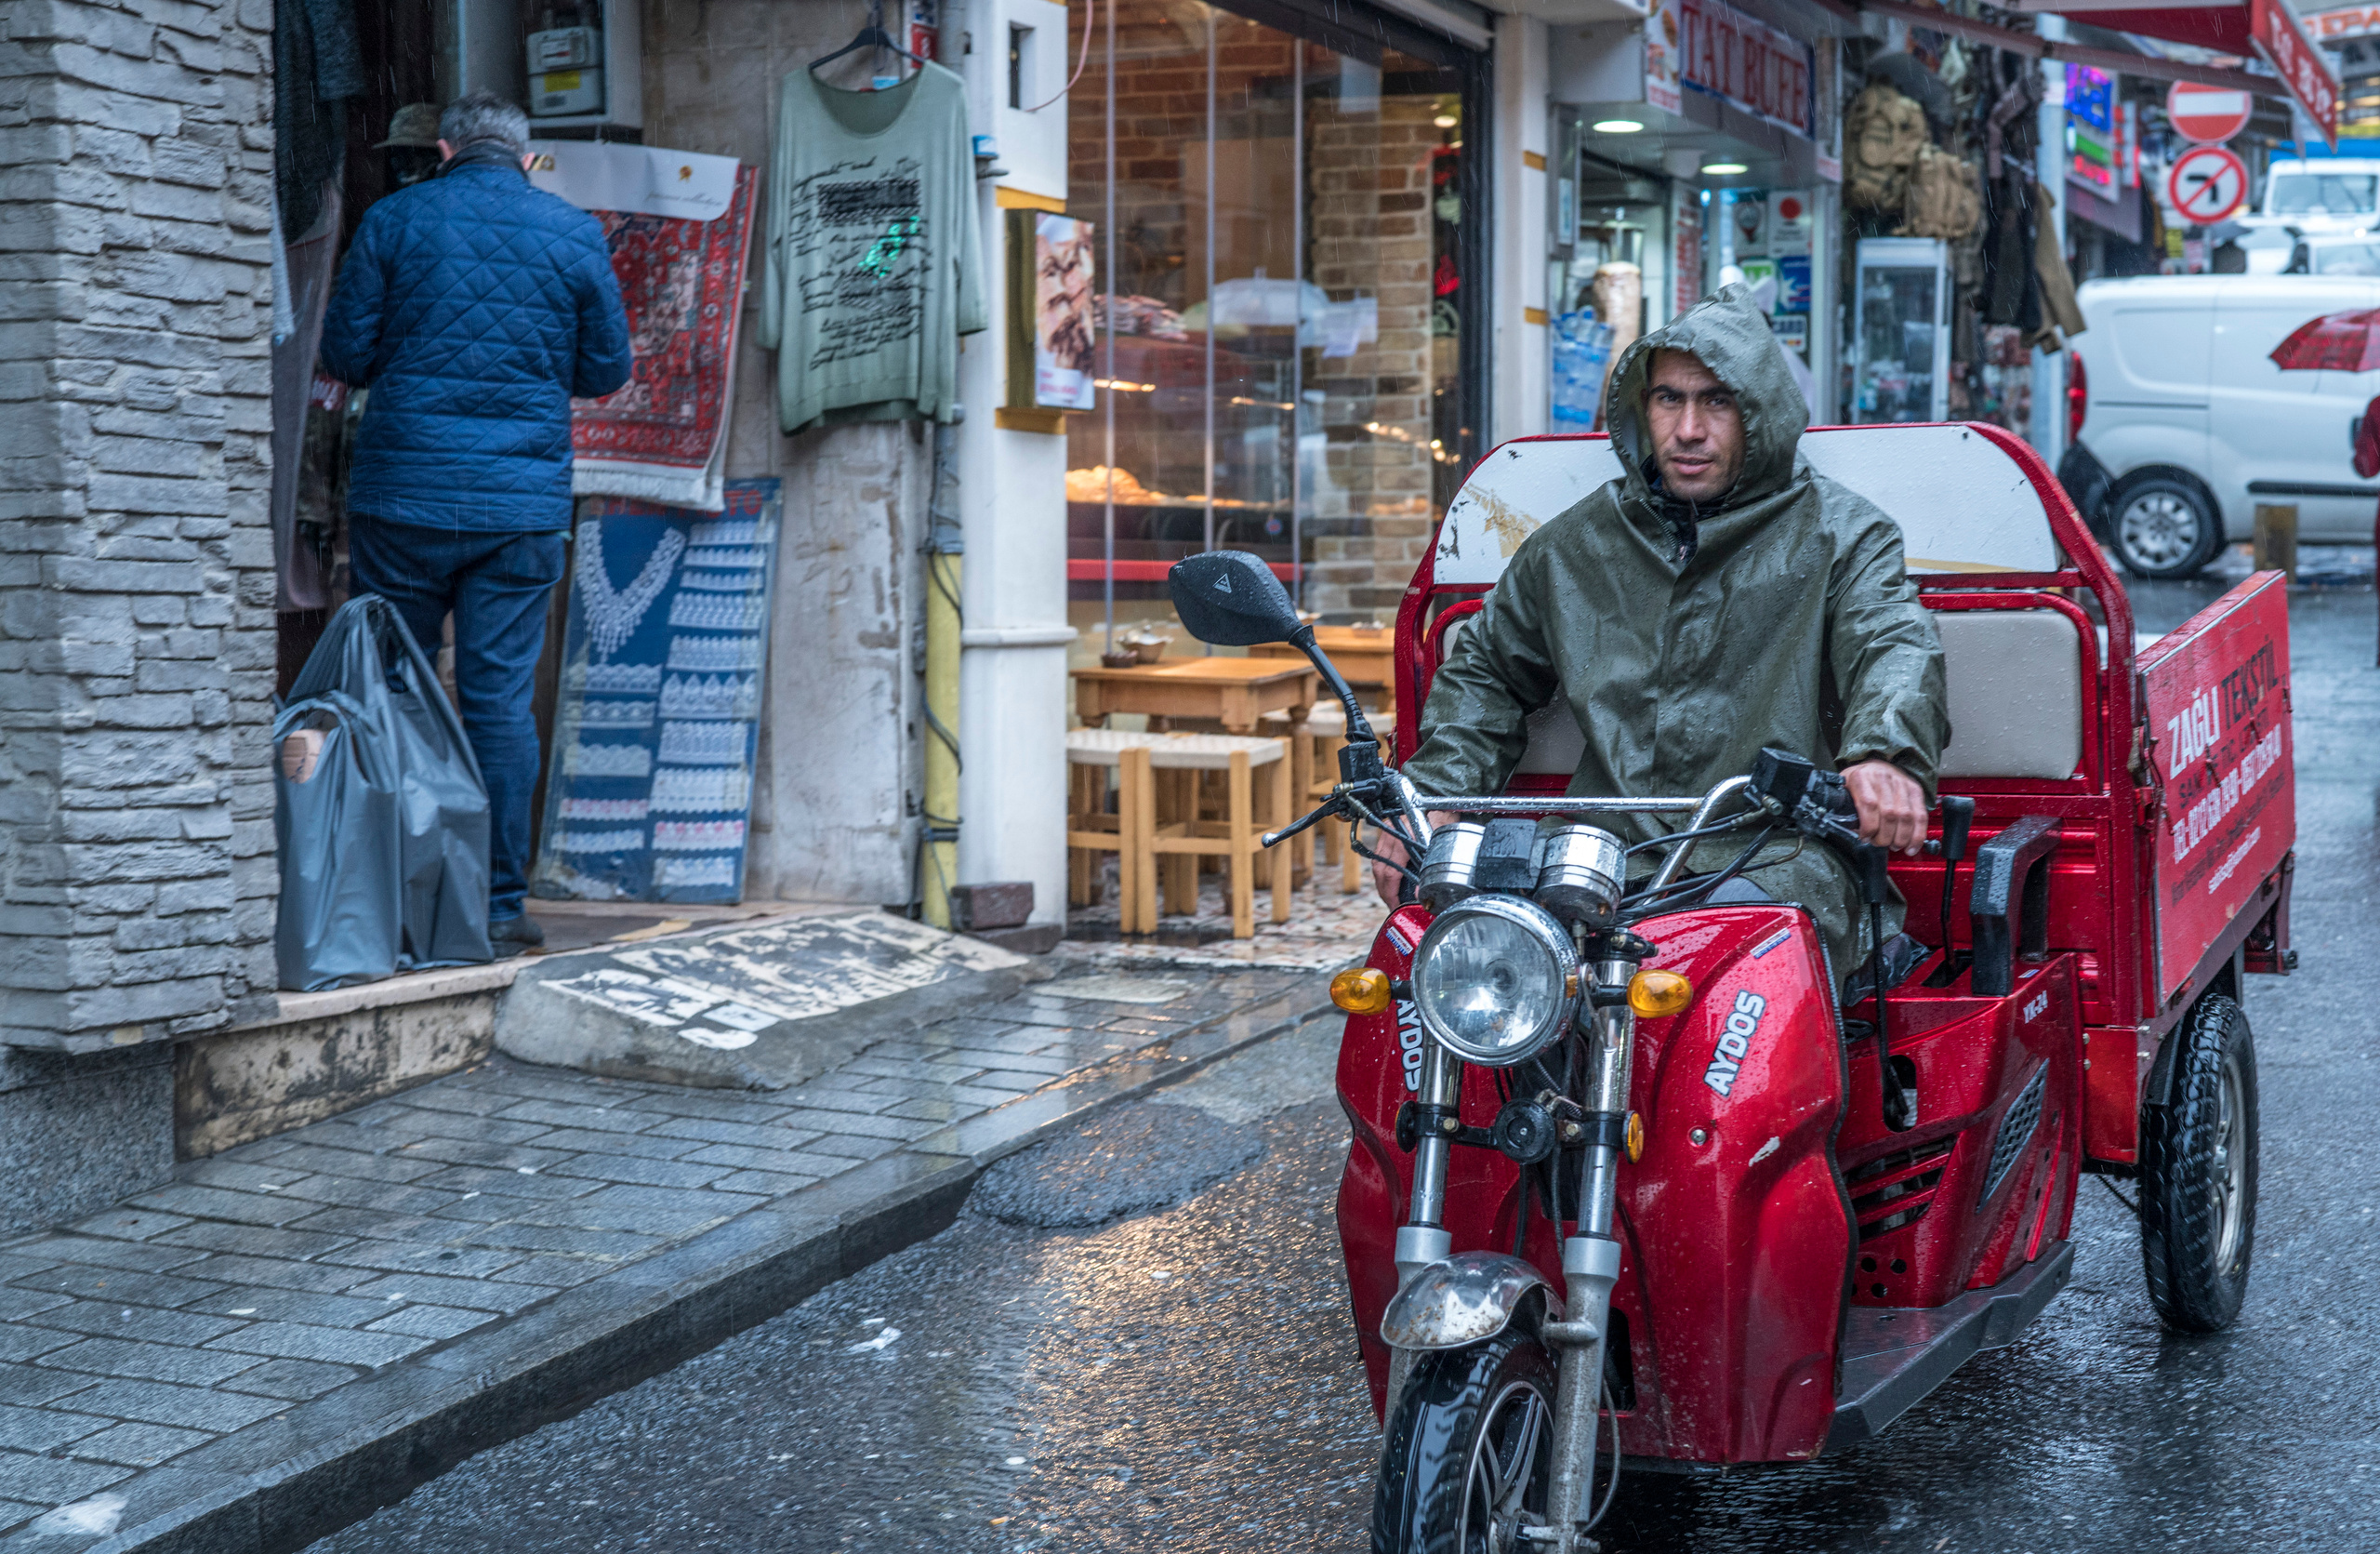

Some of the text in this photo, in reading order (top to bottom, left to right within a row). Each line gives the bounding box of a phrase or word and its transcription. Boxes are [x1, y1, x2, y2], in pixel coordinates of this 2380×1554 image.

[1681, 3, 1735, 95] TAT
[2167, 686, 2220, 780] ZAĞLI
[1703, 989, 1765, 1097] AYDOS
